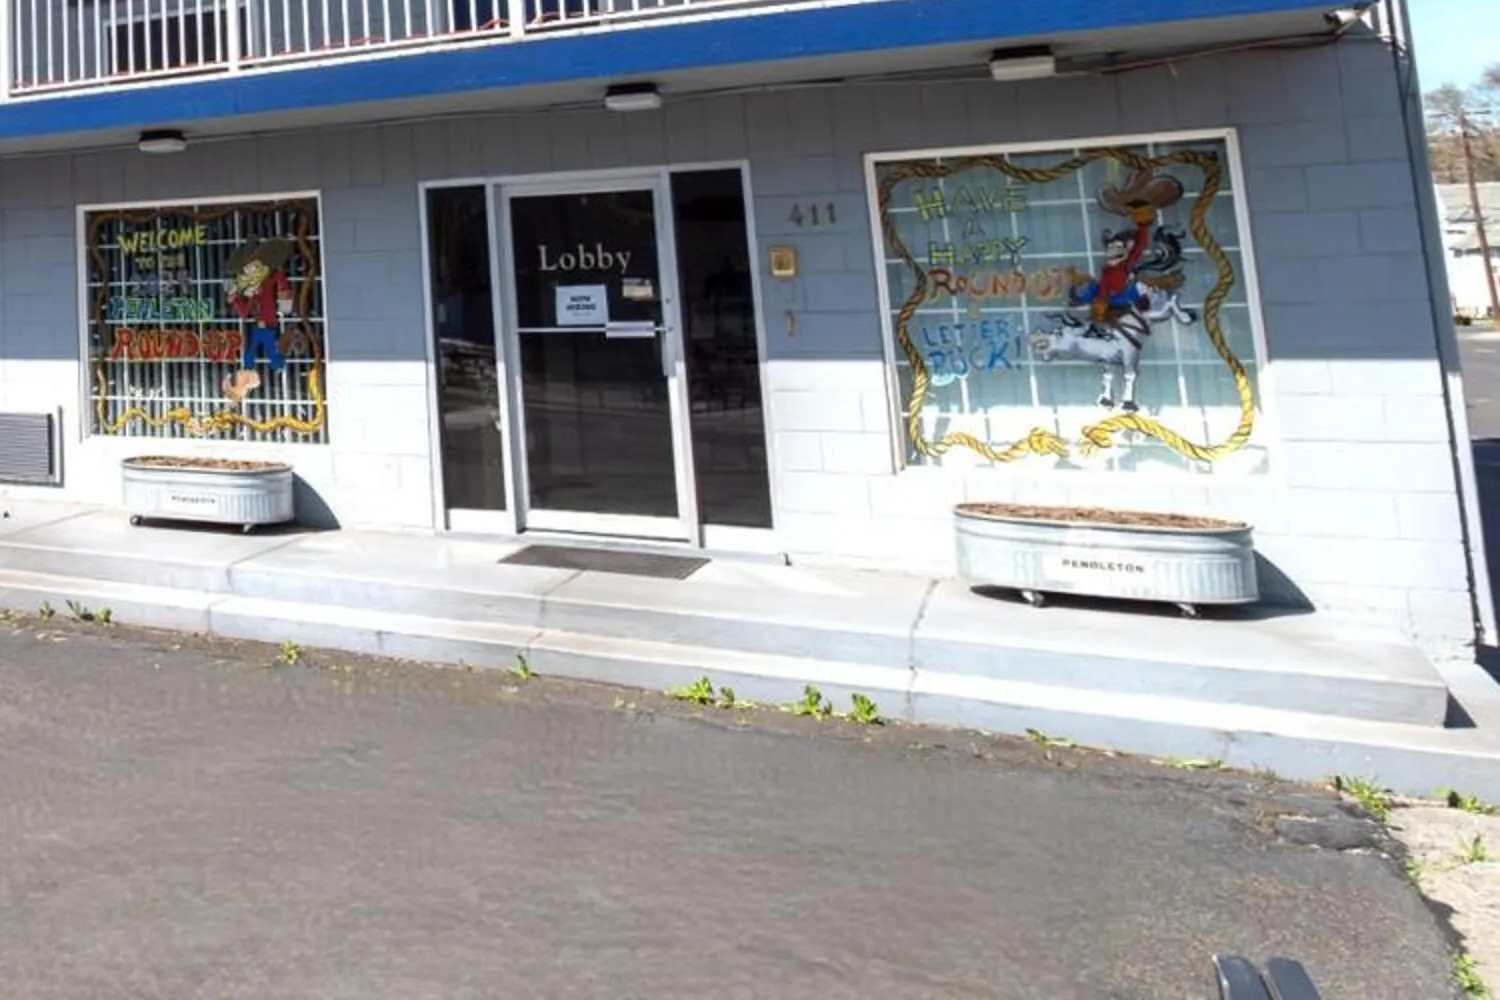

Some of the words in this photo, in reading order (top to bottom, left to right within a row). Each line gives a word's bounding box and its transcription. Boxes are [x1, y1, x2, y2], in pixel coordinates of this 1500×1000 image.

[786, 201, 837, 227] 411
[913, 183, 1028, 222] HAVE
[116, 224, 207, 256] WELCOME
[928, 235, 1029, 266] HAPPY
[538, 242, 631, 275] Lobby
[1061, 558, 1145, 574] PENDLETON
